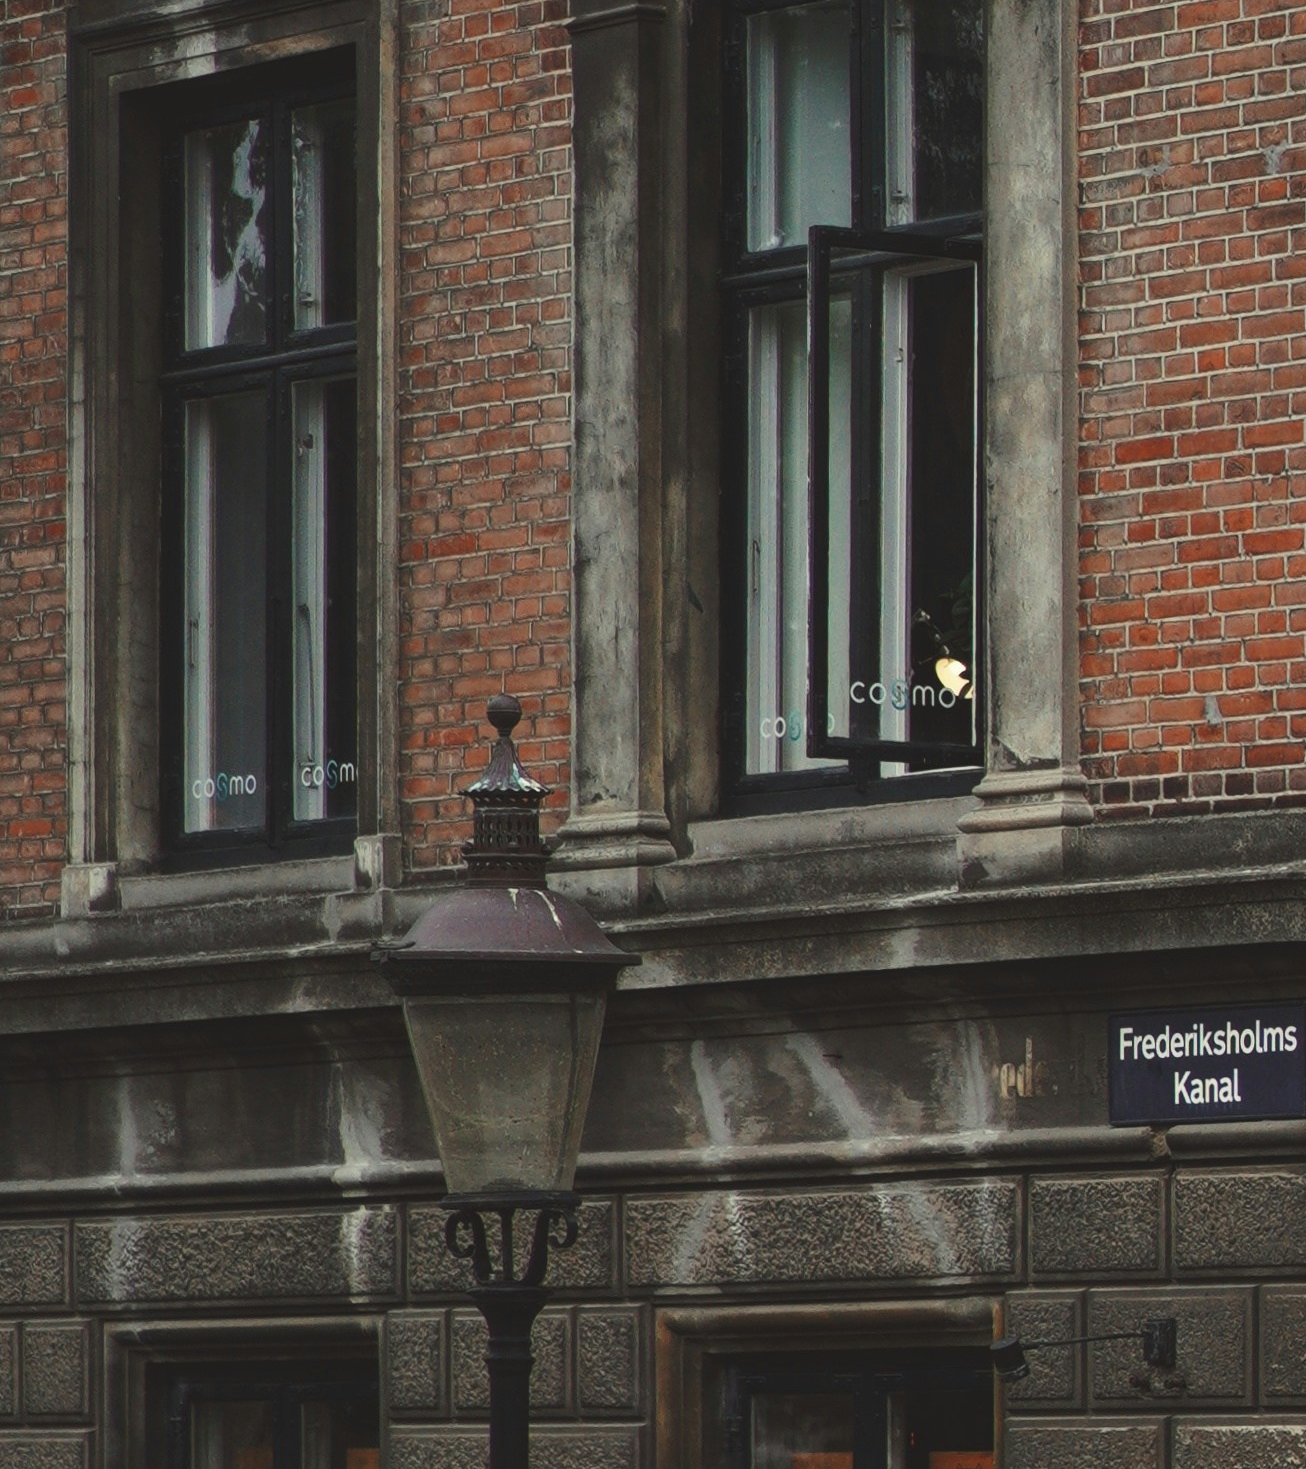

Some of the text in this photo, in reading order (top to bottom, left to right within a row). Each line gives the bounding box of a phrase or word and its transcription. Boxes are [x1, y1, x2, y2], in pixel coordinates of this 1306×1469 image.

[301, 759, 358, 790] cosm
[1119, 1019, 1298, 1061] Frederiksholms
[1174, 1068, 1242, 1105] Kanal
